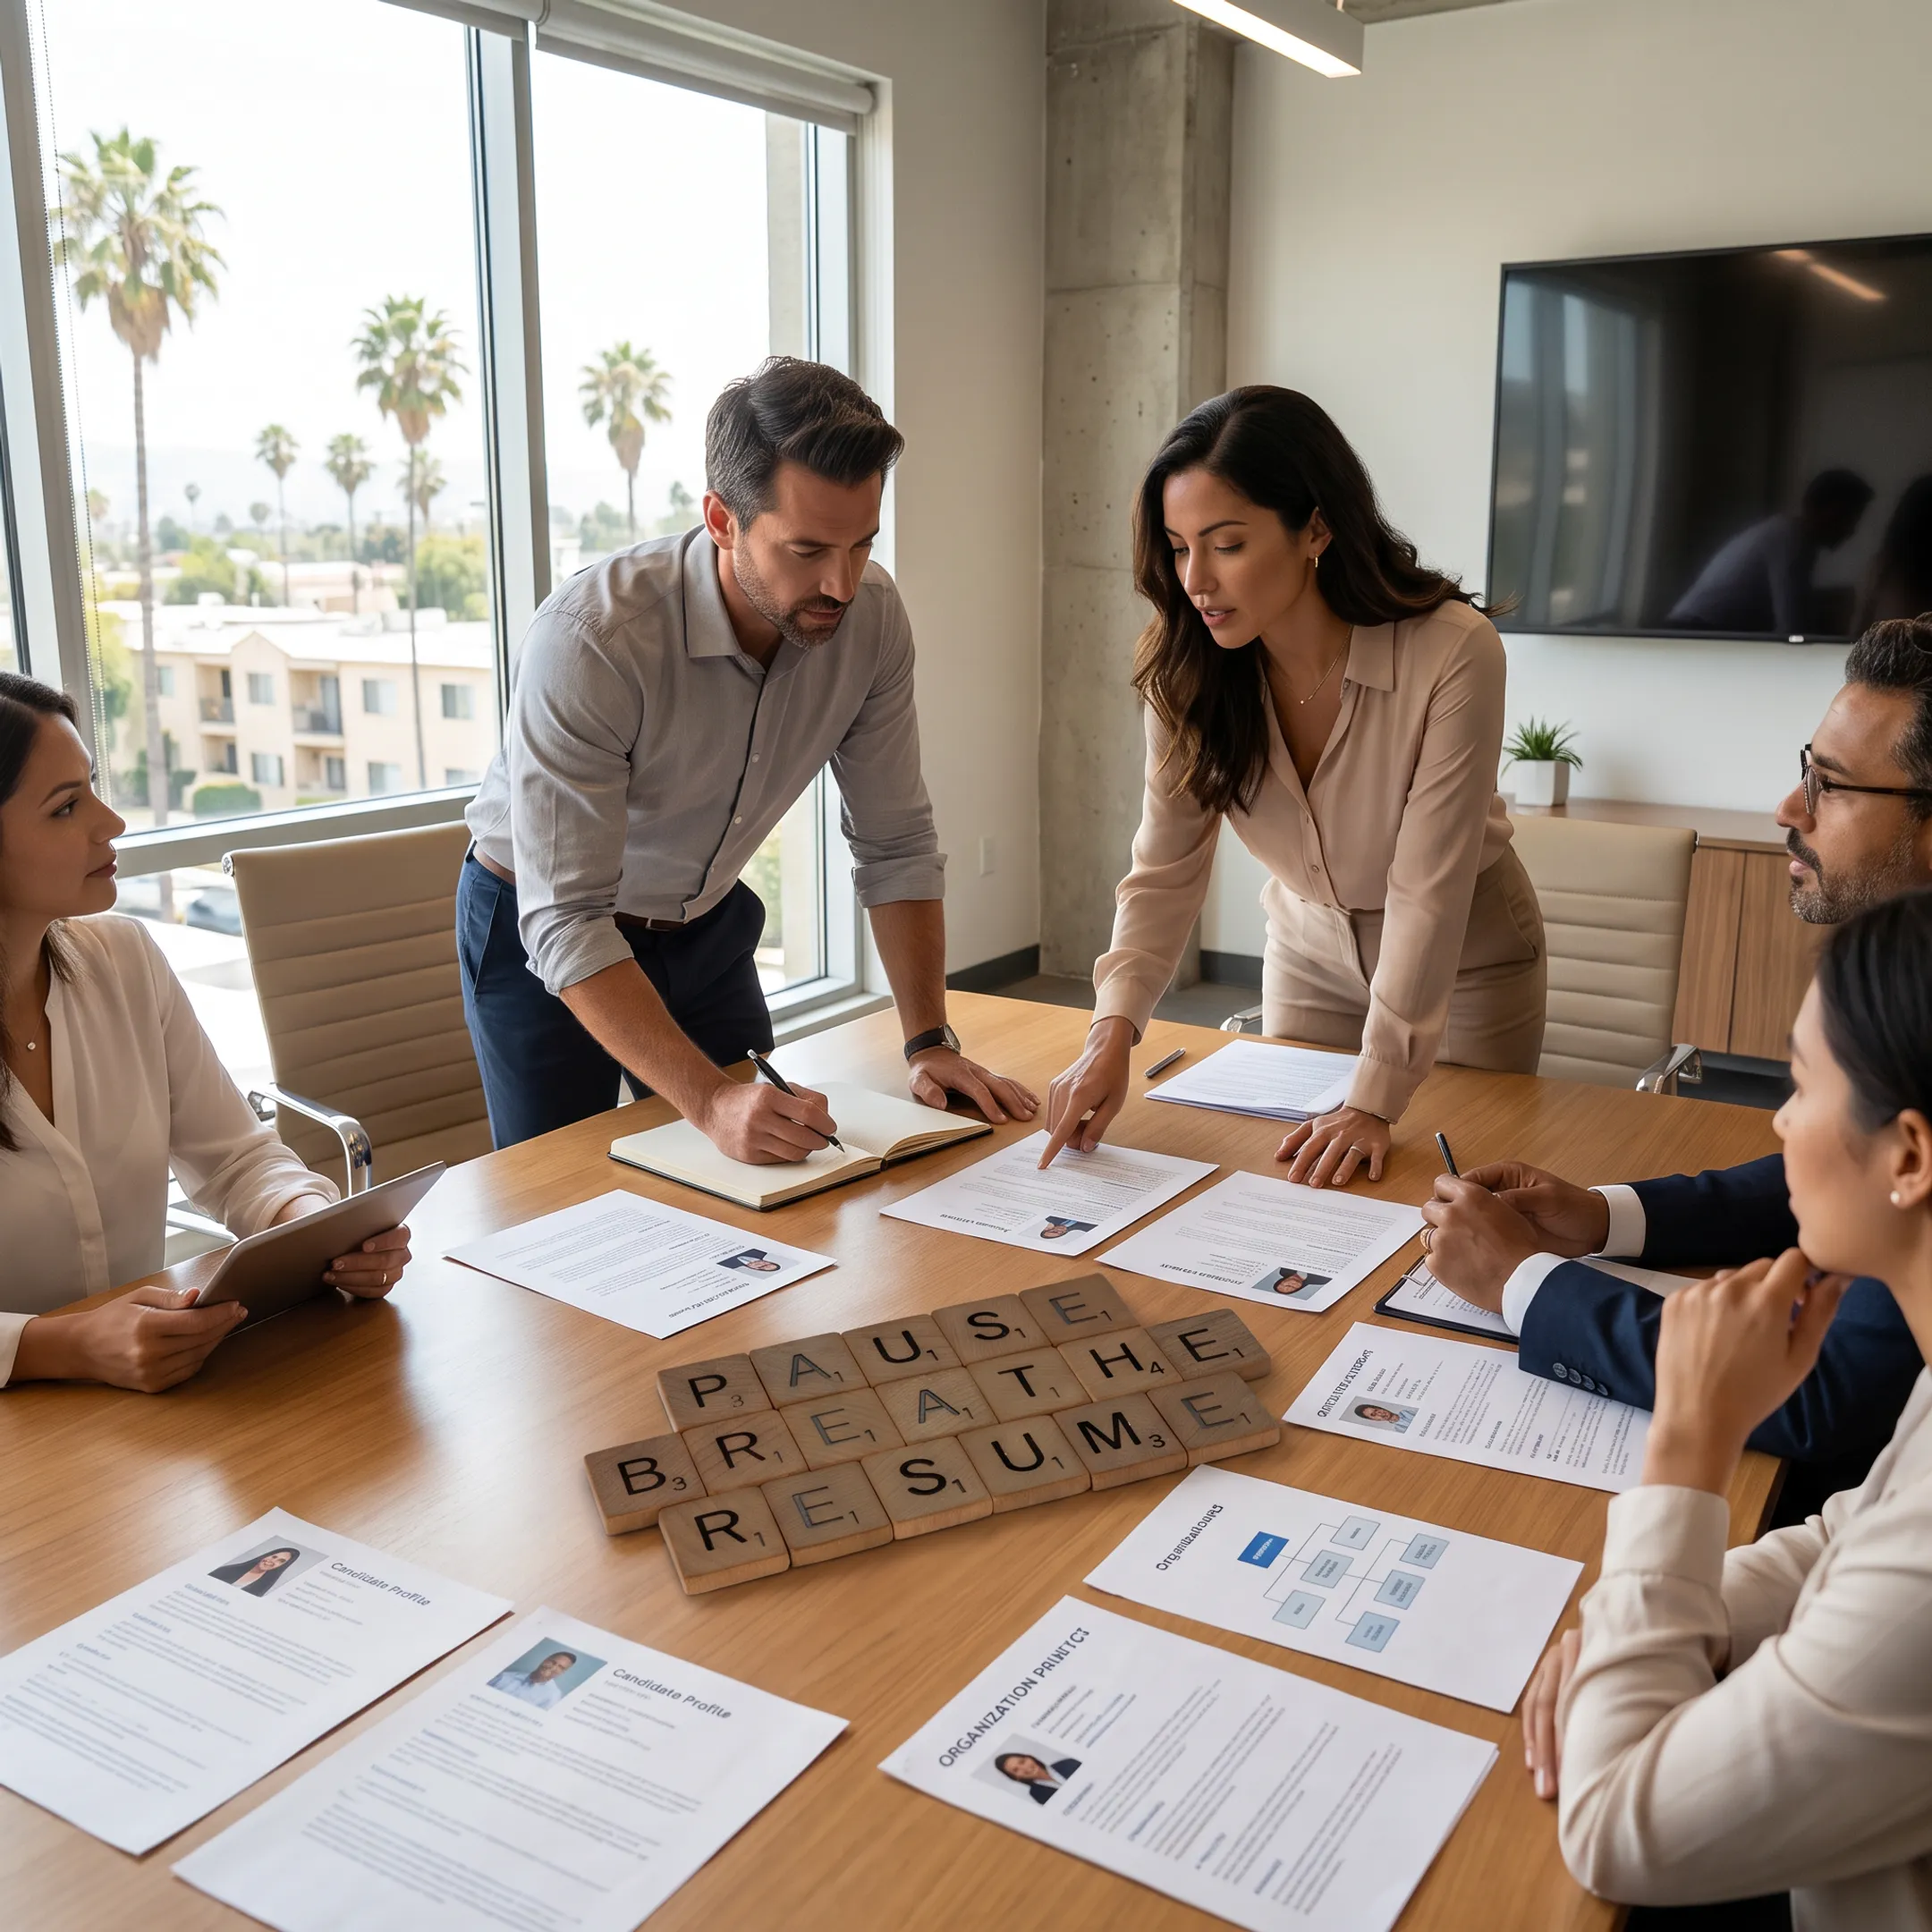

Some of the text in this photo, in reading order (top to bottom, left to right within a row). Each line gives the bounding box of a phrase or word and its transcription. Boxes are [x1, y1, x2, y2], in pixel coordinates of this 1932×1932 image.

[617, 1328, 1229, 1496] BREATHE
[688, 1292, 1097, 1408] PAUSE
[731, 1309, 1112, 1408] 3 1 1 1 1
[672, 1347, 1245, 1491] 3 1 1 1 1 4 1
[694, 1392, 1234, 1551] RESUME
[754, 1412, 1250, 1546] 1 1 1 1 3 1
[613, 1668, 732, 1718] Candidate Profile
[938, 1677, 1038, 1767] ORGANIZATION
